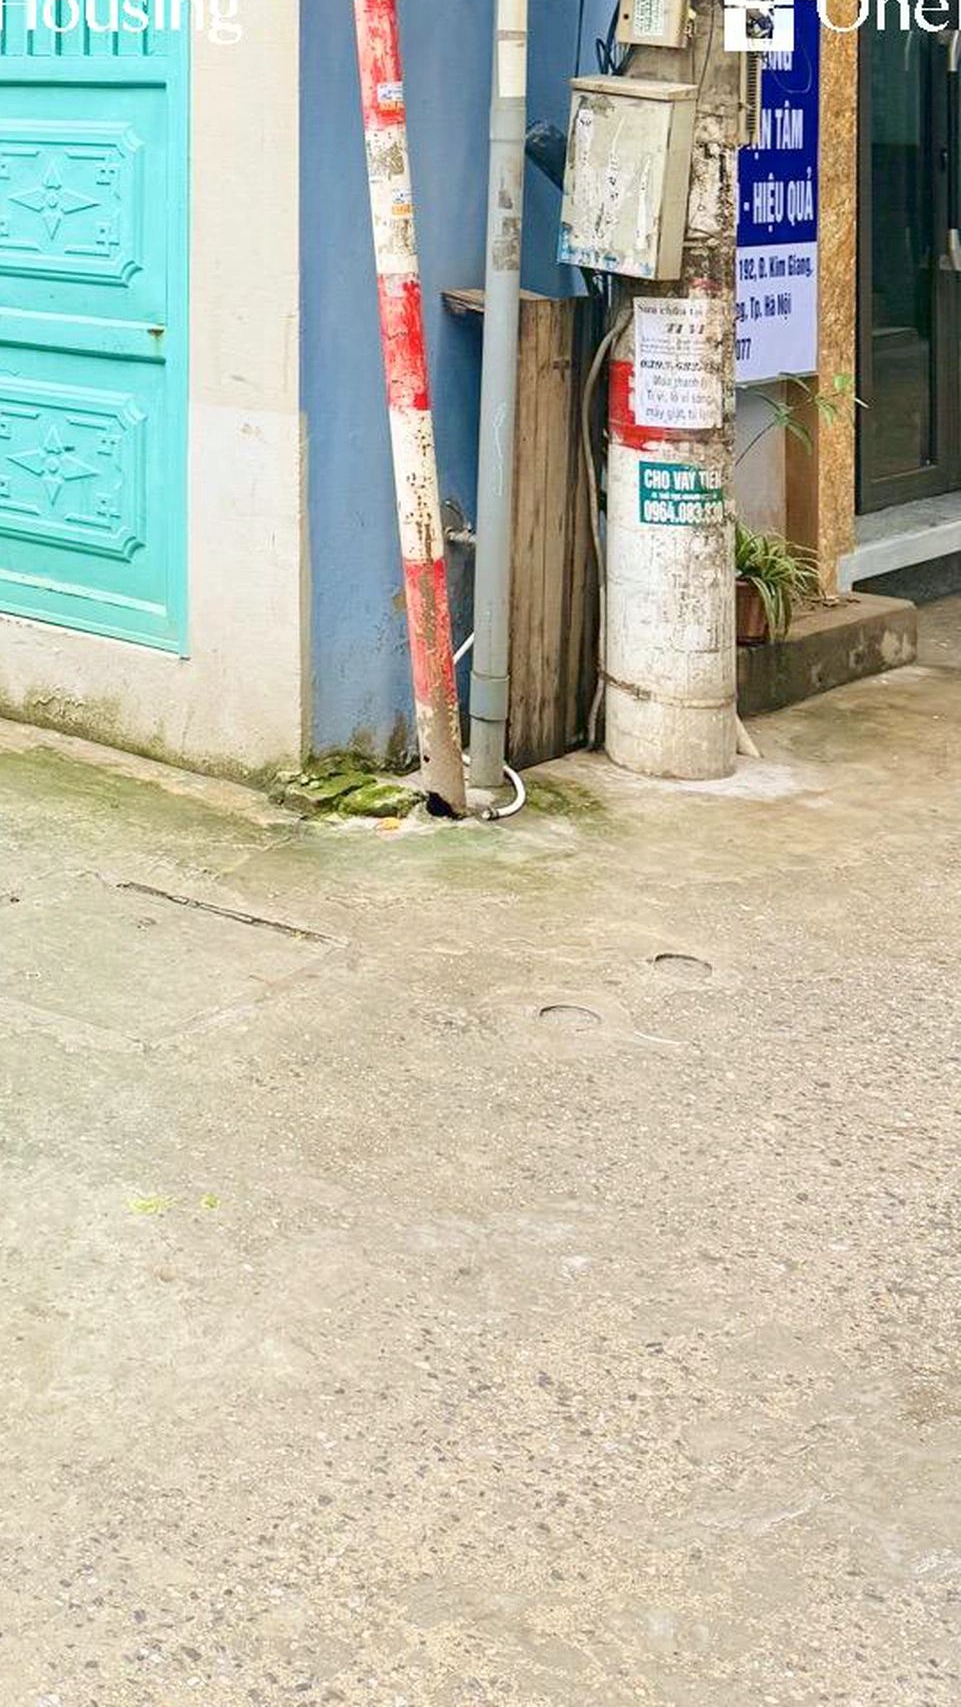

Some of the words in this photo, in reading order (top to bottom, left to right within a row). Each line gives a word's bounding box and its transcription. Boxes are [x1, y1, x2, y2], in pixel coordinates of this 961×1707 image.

[775, 100, 803, 150] TÂM
[753, 172, 784, 232] HIỆU
[787, 166, 813, 226] QUẢ
[769, 256, 785, 277] Kim
[644, 469, 670, 489] CHO
[672, 470, 696, 490] VAY
